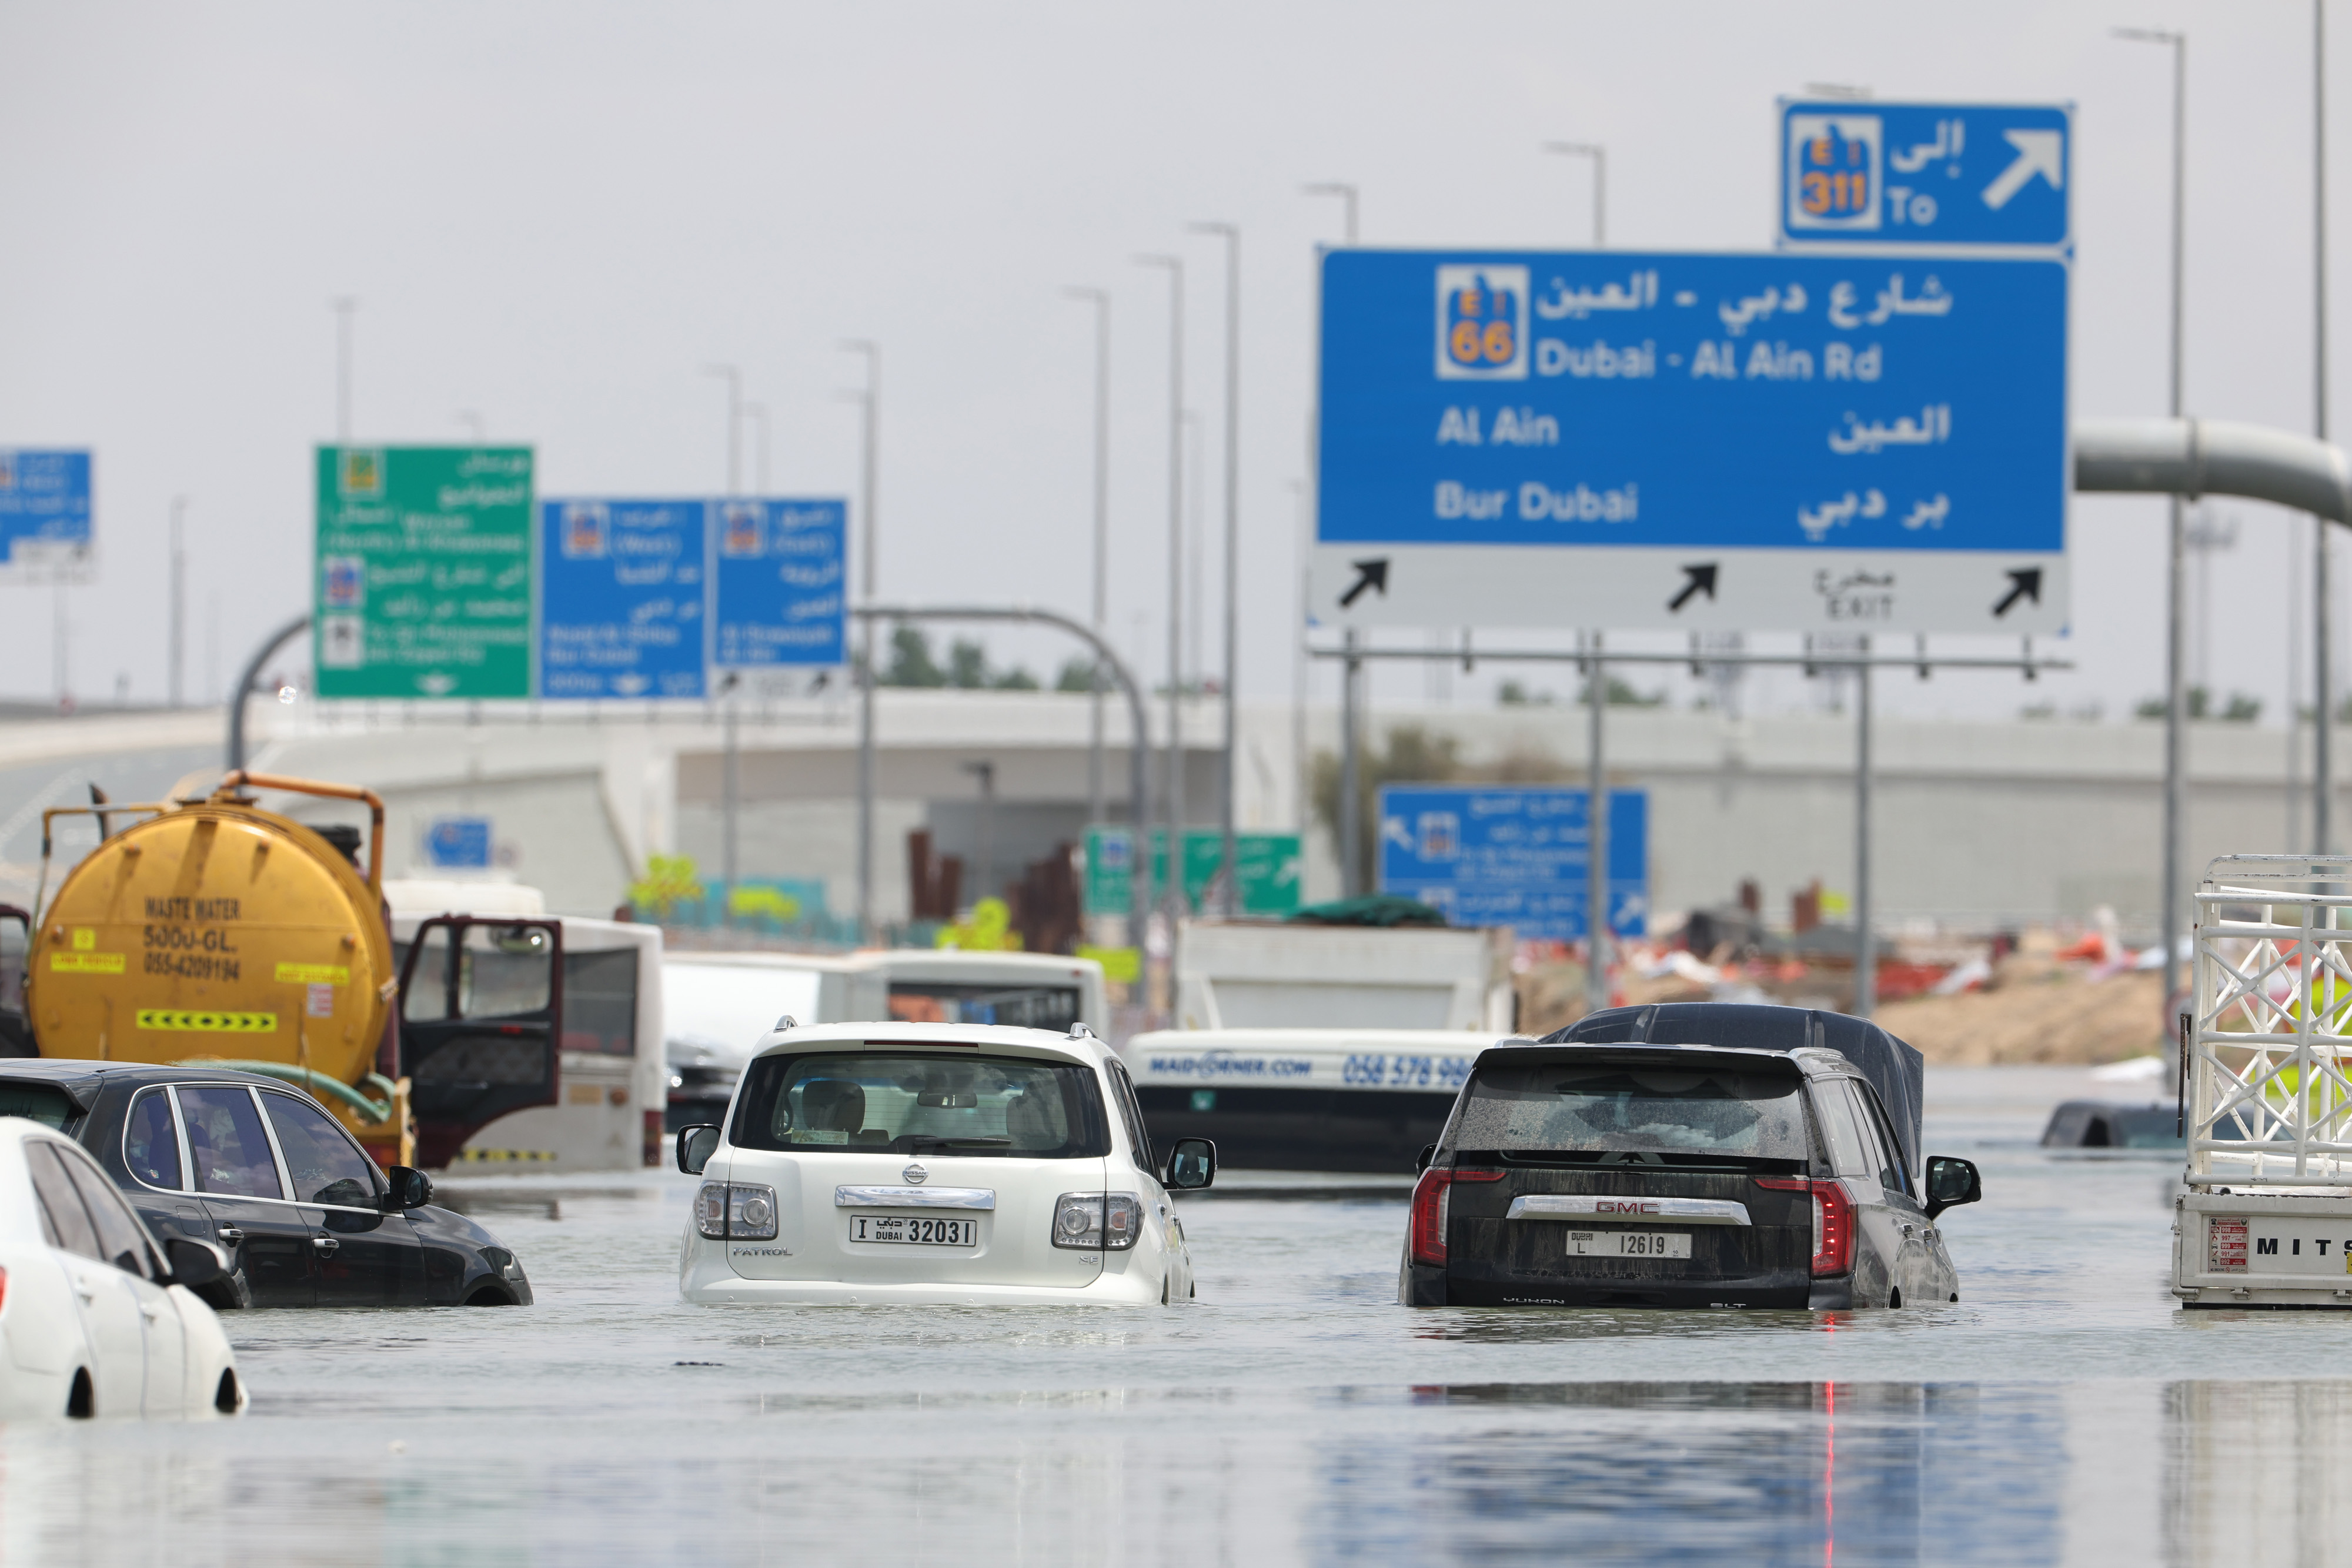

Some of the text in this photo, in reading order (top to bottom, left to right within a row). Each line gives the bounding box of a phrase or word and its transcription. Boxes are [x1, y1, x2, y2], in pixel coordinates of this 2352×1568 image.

[1890, 118, 1965, 179] إلى
[1802, 170, 1866, 215] 311
[1885, 186, 1939, 226] To
[1535, 269, 1658, 320] العين
[1718, 283, 1808, 337] دبي
[1828, 274, 1952, 329] شارع
[1451, 319, 1514, 364] 66
[1536, 339, 1656, 378] Dubai
[1691, 340, 1737, 380] Al
[1744, 340, 1815, 380] Ain
[1825, 342, 1882, 382] Rd
[1436, 406, 1559, 447] Al Ain
[1828, 403, 1950, 453] العين
[1434, 480, 1639, 522] Bur Dubai
[1798, 489, 1950, 541] بر دبي
[1829, 597, 1895, 619] EXIT
[145, 897, 242, 921] WASTE WATER
[877, 1220, 902, 1229] دبي
[1596, 1202, 1659, 1215] GMC
[859, 1219, 867, 1239] I
[876, 1231, 902, 1241] DUBAI
[908, 1220, 970, 1243] 32031
[1577, 1242, 1586, 1253] L
[1621, 1235, 1665, 1255] 12619
[733, 1247, 793, 1256] PATROL
[1080, 1256, 1098, 1265] SE
